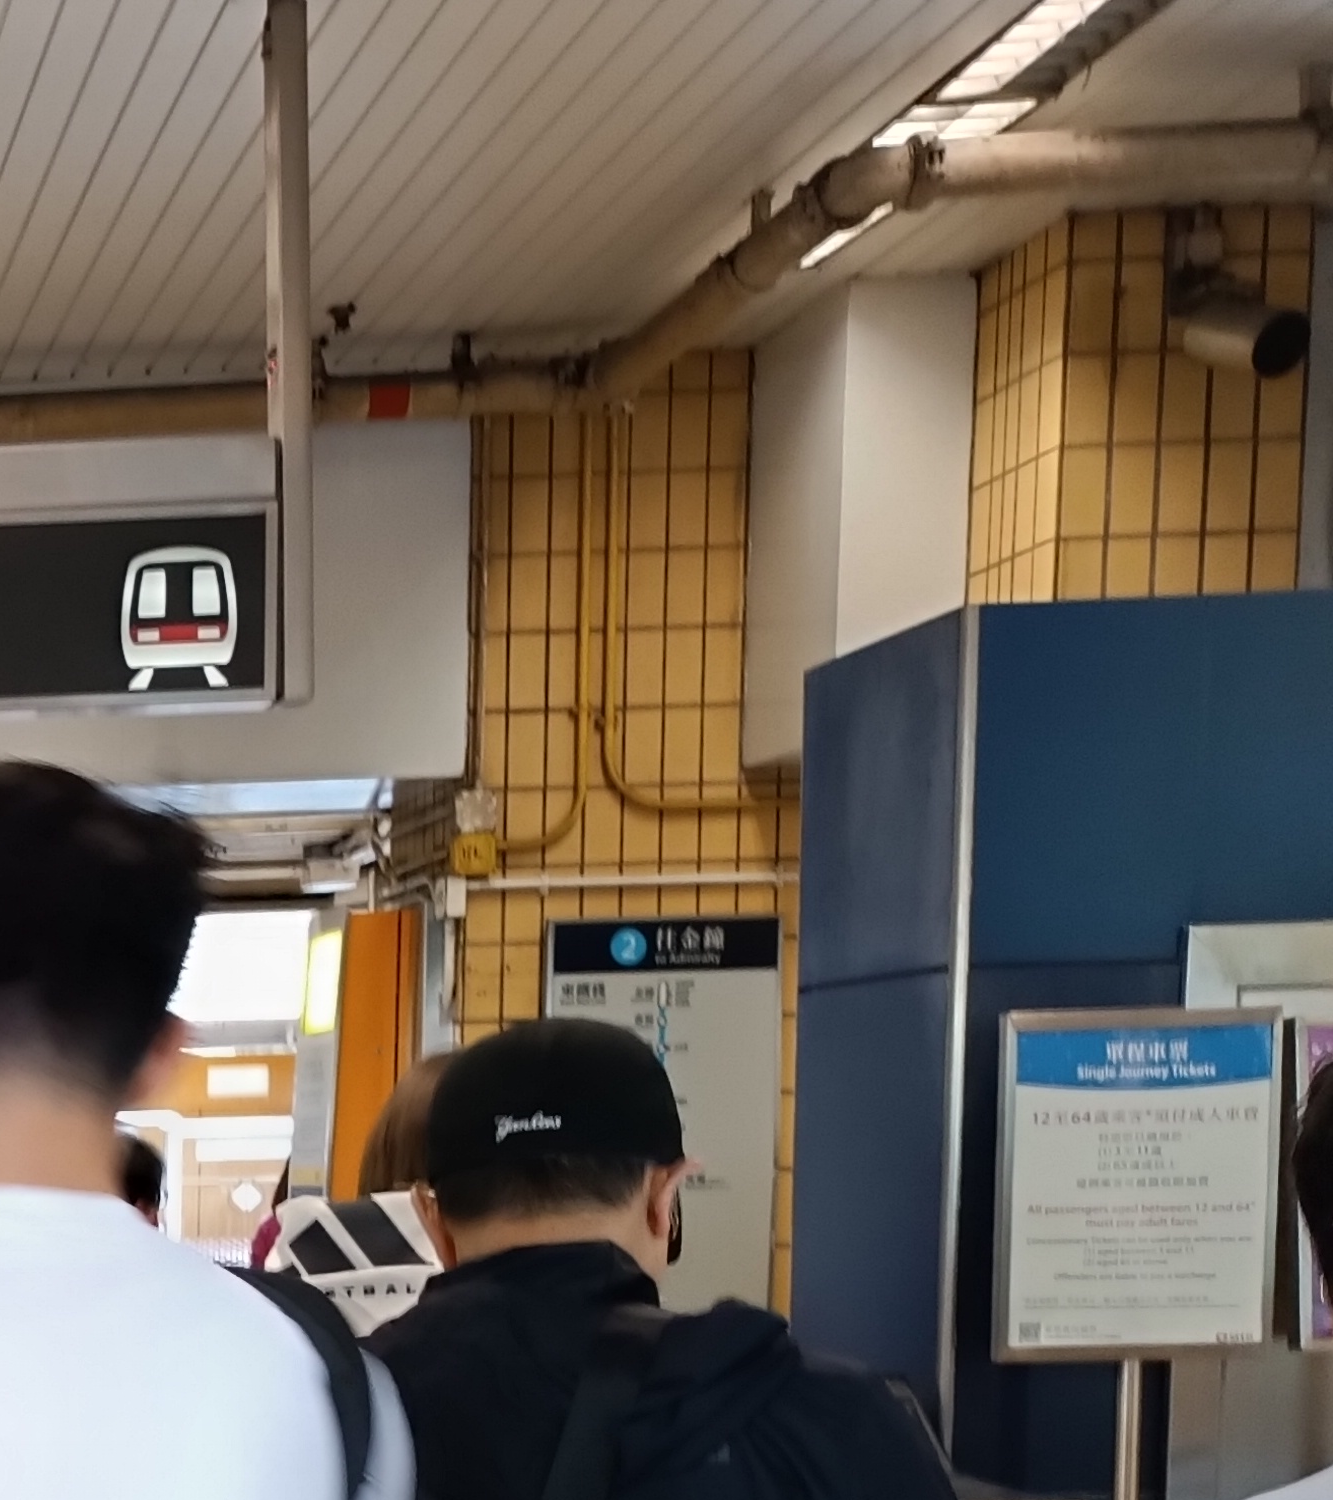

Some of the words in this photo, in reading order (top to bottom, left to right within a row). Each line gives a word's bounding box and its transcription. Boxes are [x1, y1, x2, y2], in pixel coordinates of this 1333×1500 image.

[620, 931, 637, 960] 2
[1077, 1062, 1117, 1083] Single
[1119, 1063, 1169, 1082] Journey
[1172, 1060, 1216, 1079] Tickets
